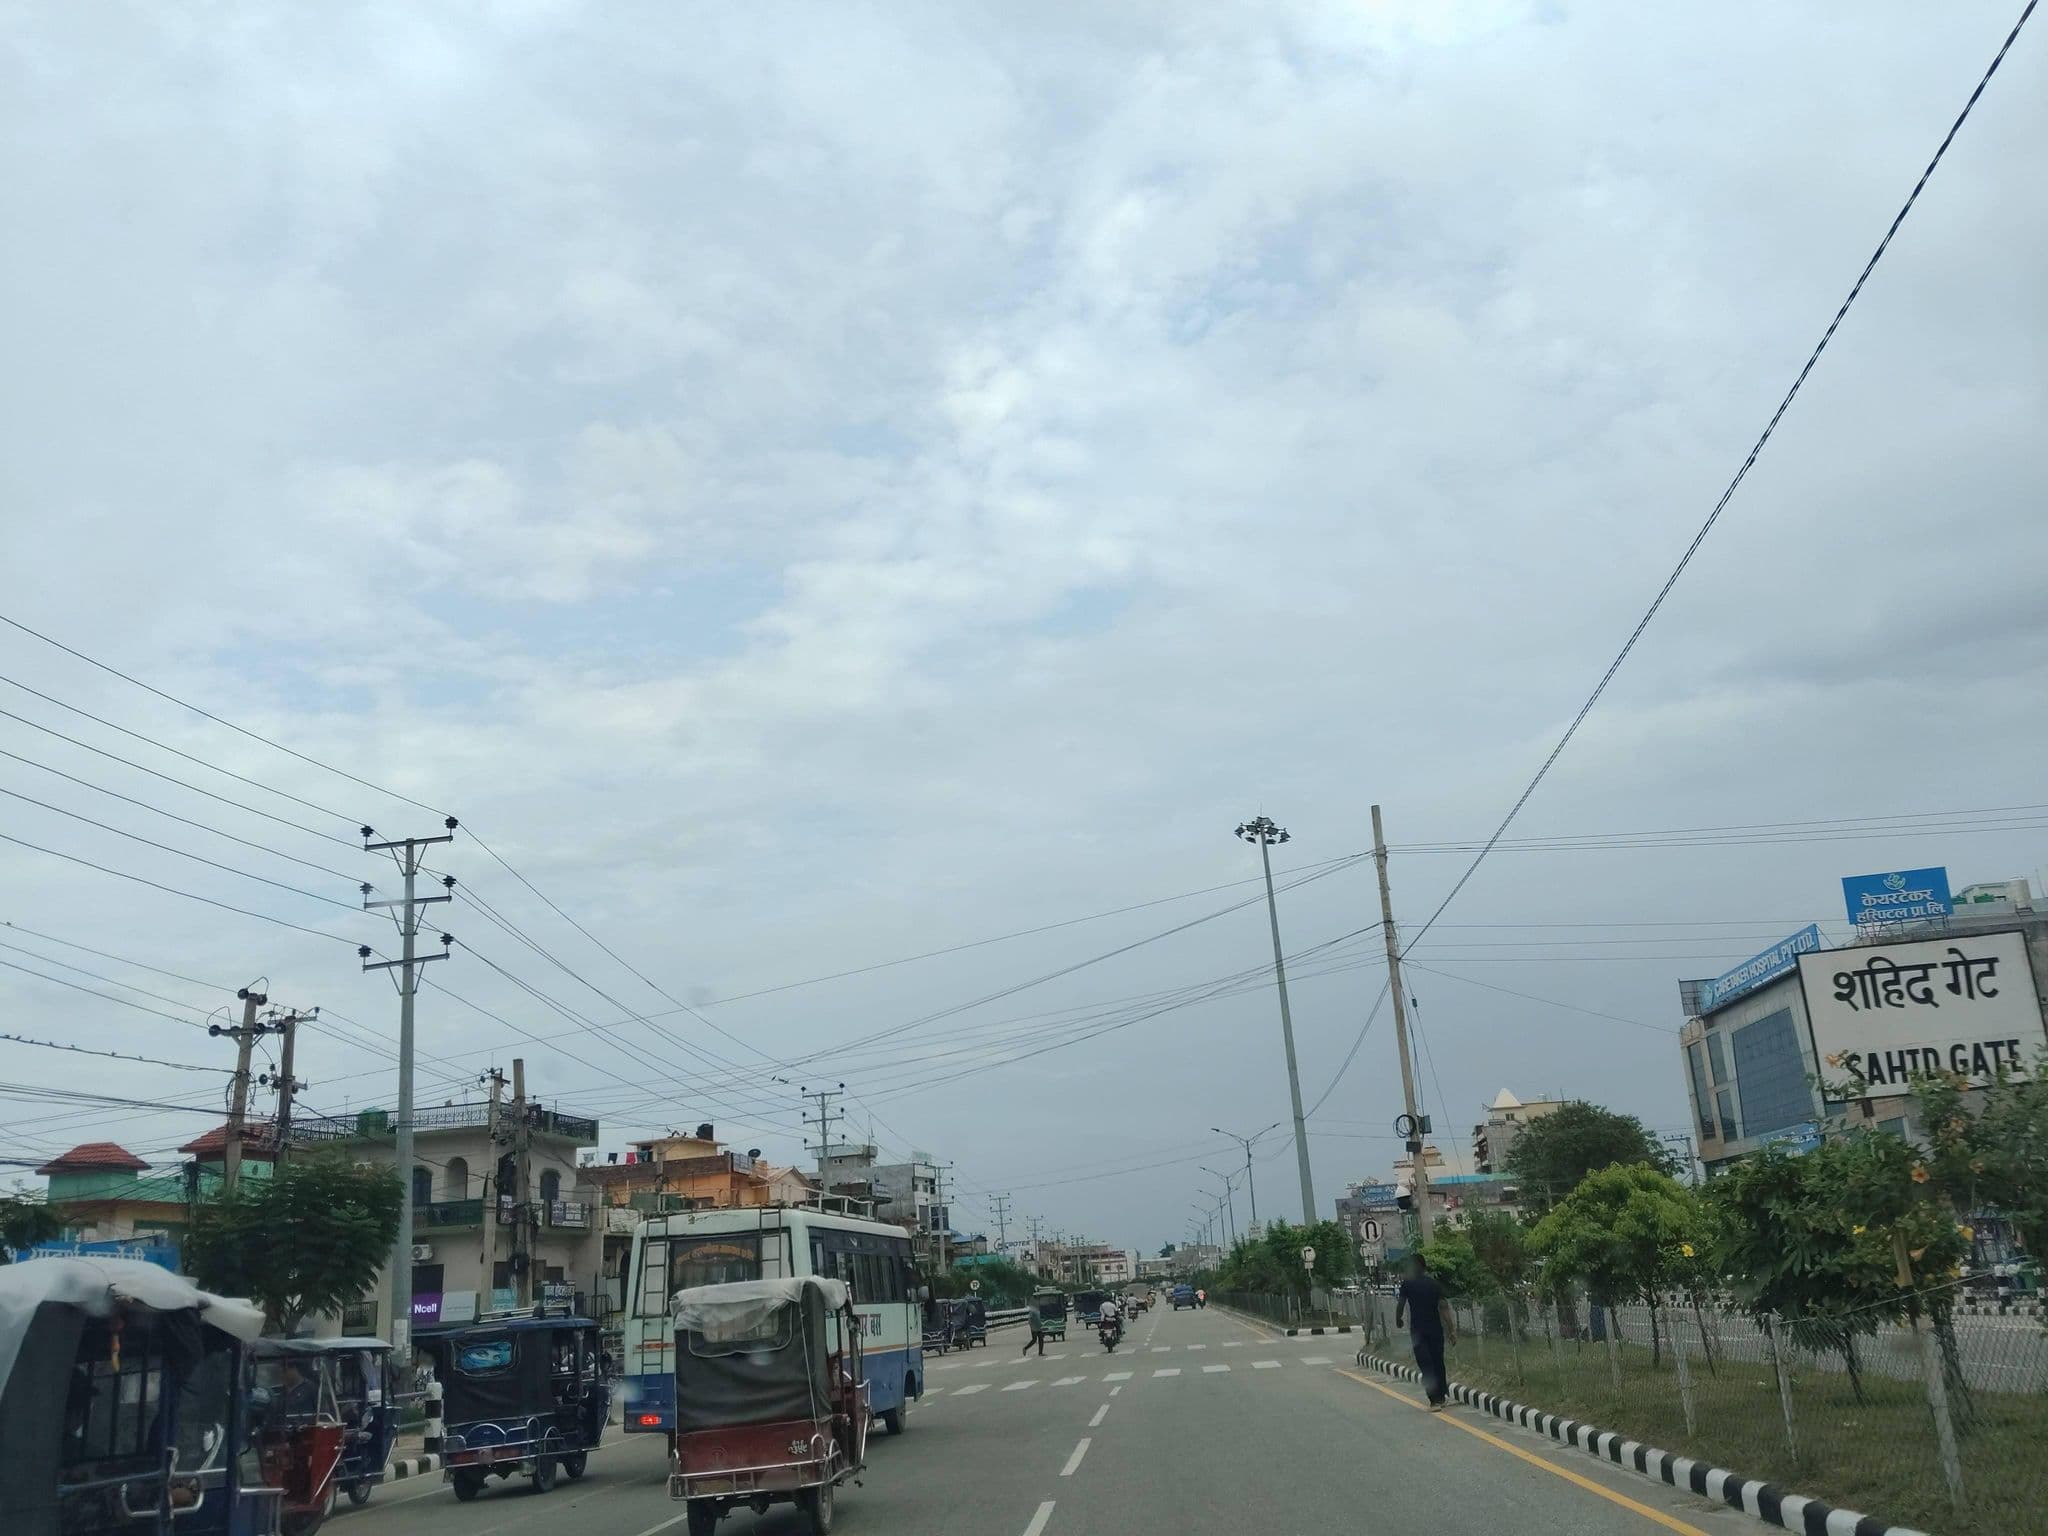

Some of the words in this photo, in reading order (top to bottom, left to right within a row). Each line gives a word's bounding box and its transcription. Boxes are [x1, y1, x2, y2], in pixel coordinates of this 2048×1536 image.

[1861, 889, 1935, 906] केयरटेकर
[1749, 950, 1782, 980] HOSPITAL
[1833, 956, 1940, 1012] शहिद
[1942, 947, 2000, 1000] गेट
[1950, 1038, 2024, 1076] GATE
[415, 1303, 437, 1314] Ncell
